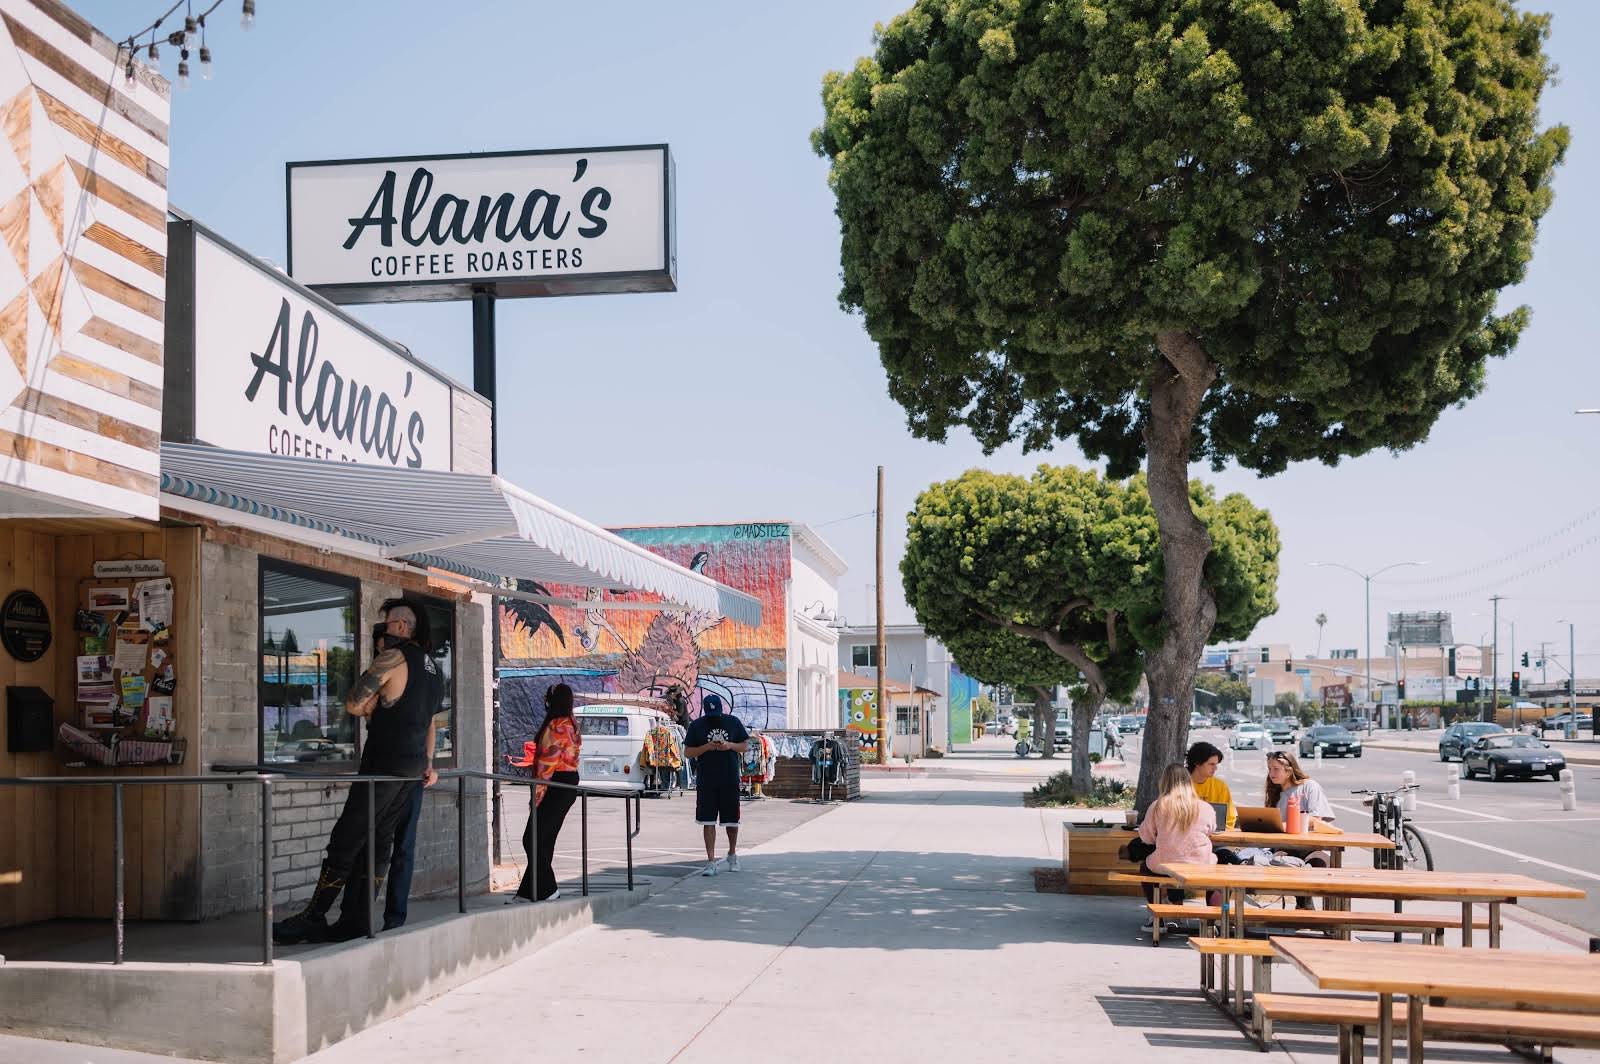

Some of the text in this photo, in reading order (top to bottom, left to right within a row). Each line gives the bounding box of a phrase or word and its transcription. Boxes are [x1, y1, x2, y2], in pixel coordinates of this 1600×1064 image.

[342, 158, 612, 249] Alana's
[371, 247, 583, 277] COFFEE ROASTERS
[244, 297, 424, 468] Alana's
[733, 524, 790, 538] @MADSTEEZ
